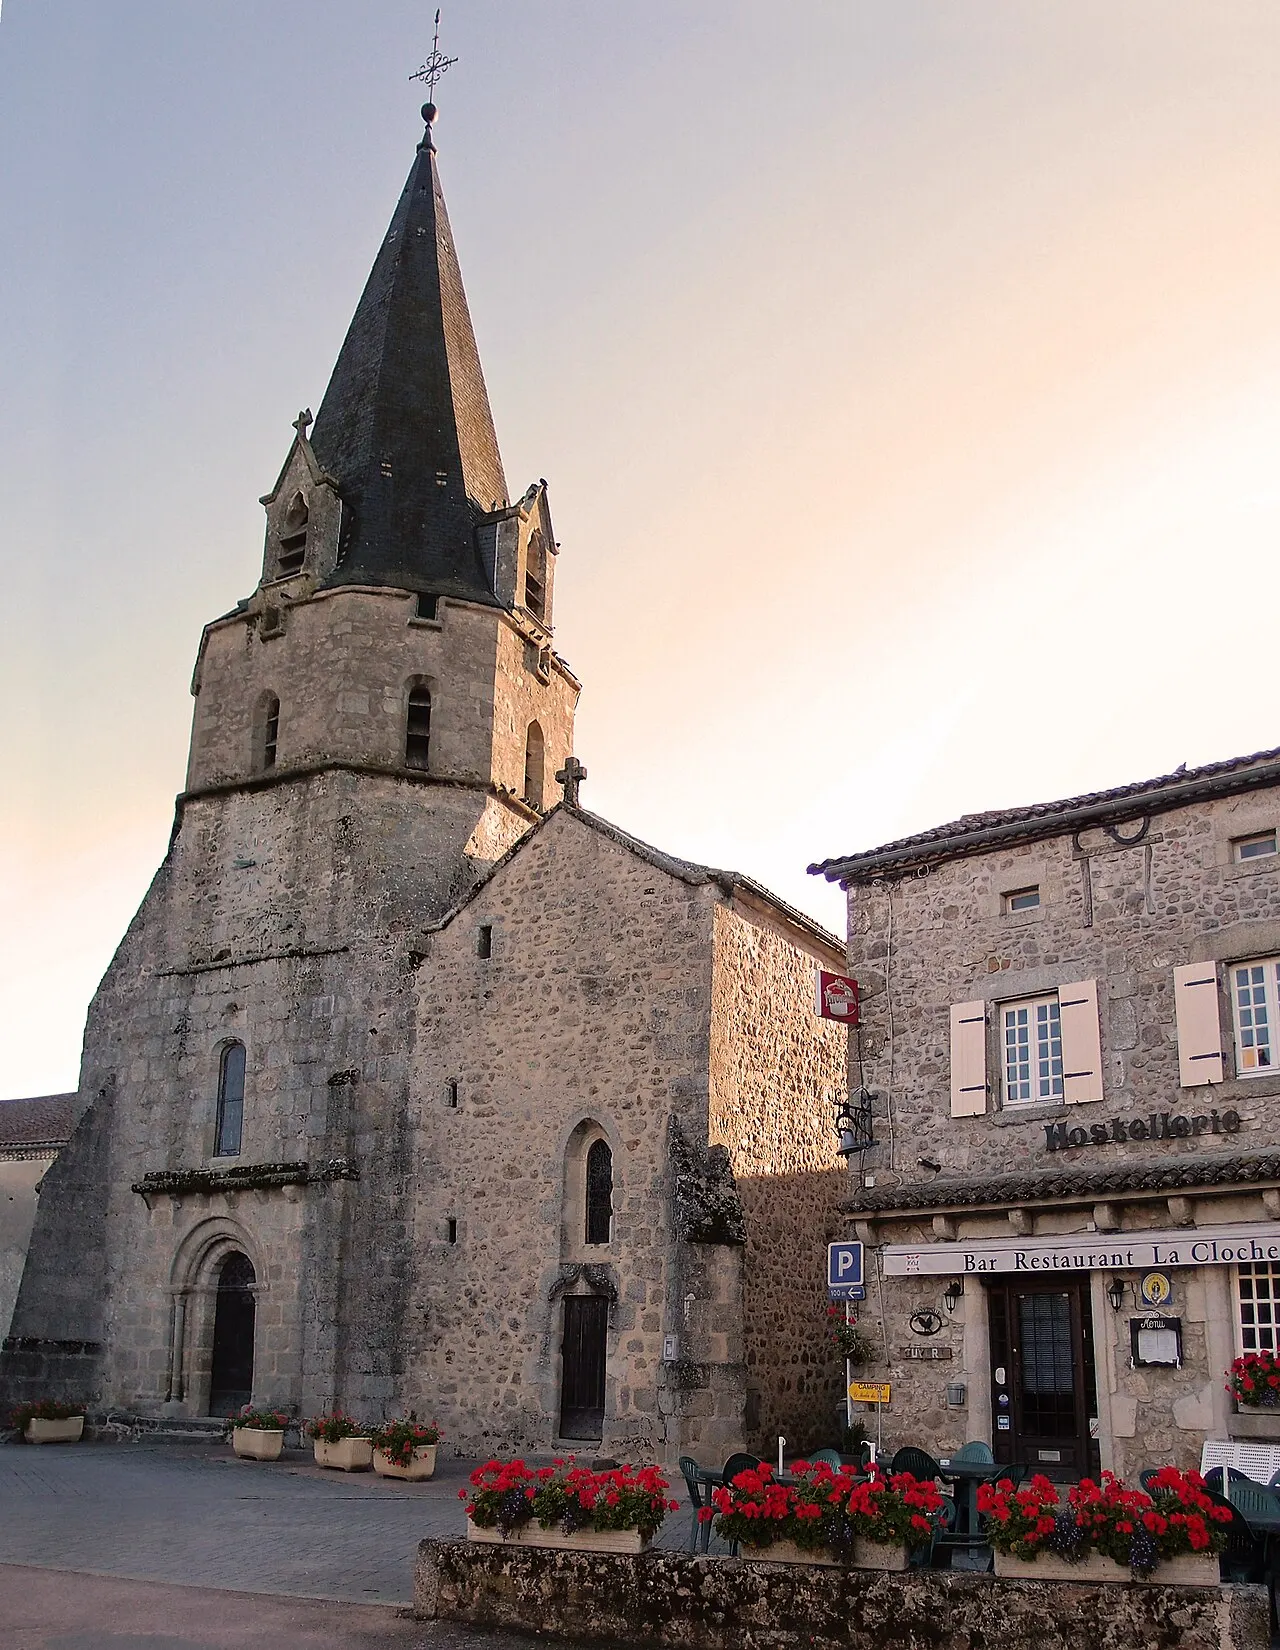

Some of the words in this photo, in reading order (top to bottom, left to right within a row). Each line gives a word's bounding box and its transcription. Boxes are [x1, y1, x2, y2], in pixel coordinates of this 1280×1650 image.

[1043, 1108, 1241, 1151] Hostellerie
[838, 1251, 853, 1277] P
[963, 1254, 998, 1272] Bar
[1014, 1250, 1134, 1270] Restaurant
[1151, 1245, 1180, 1265] La
[1191, 1239, 1279, 1263] Cloche
[1140, 1318, 1166, 1329] Menu
[857, 1383, 886, 1391] CAMPING
